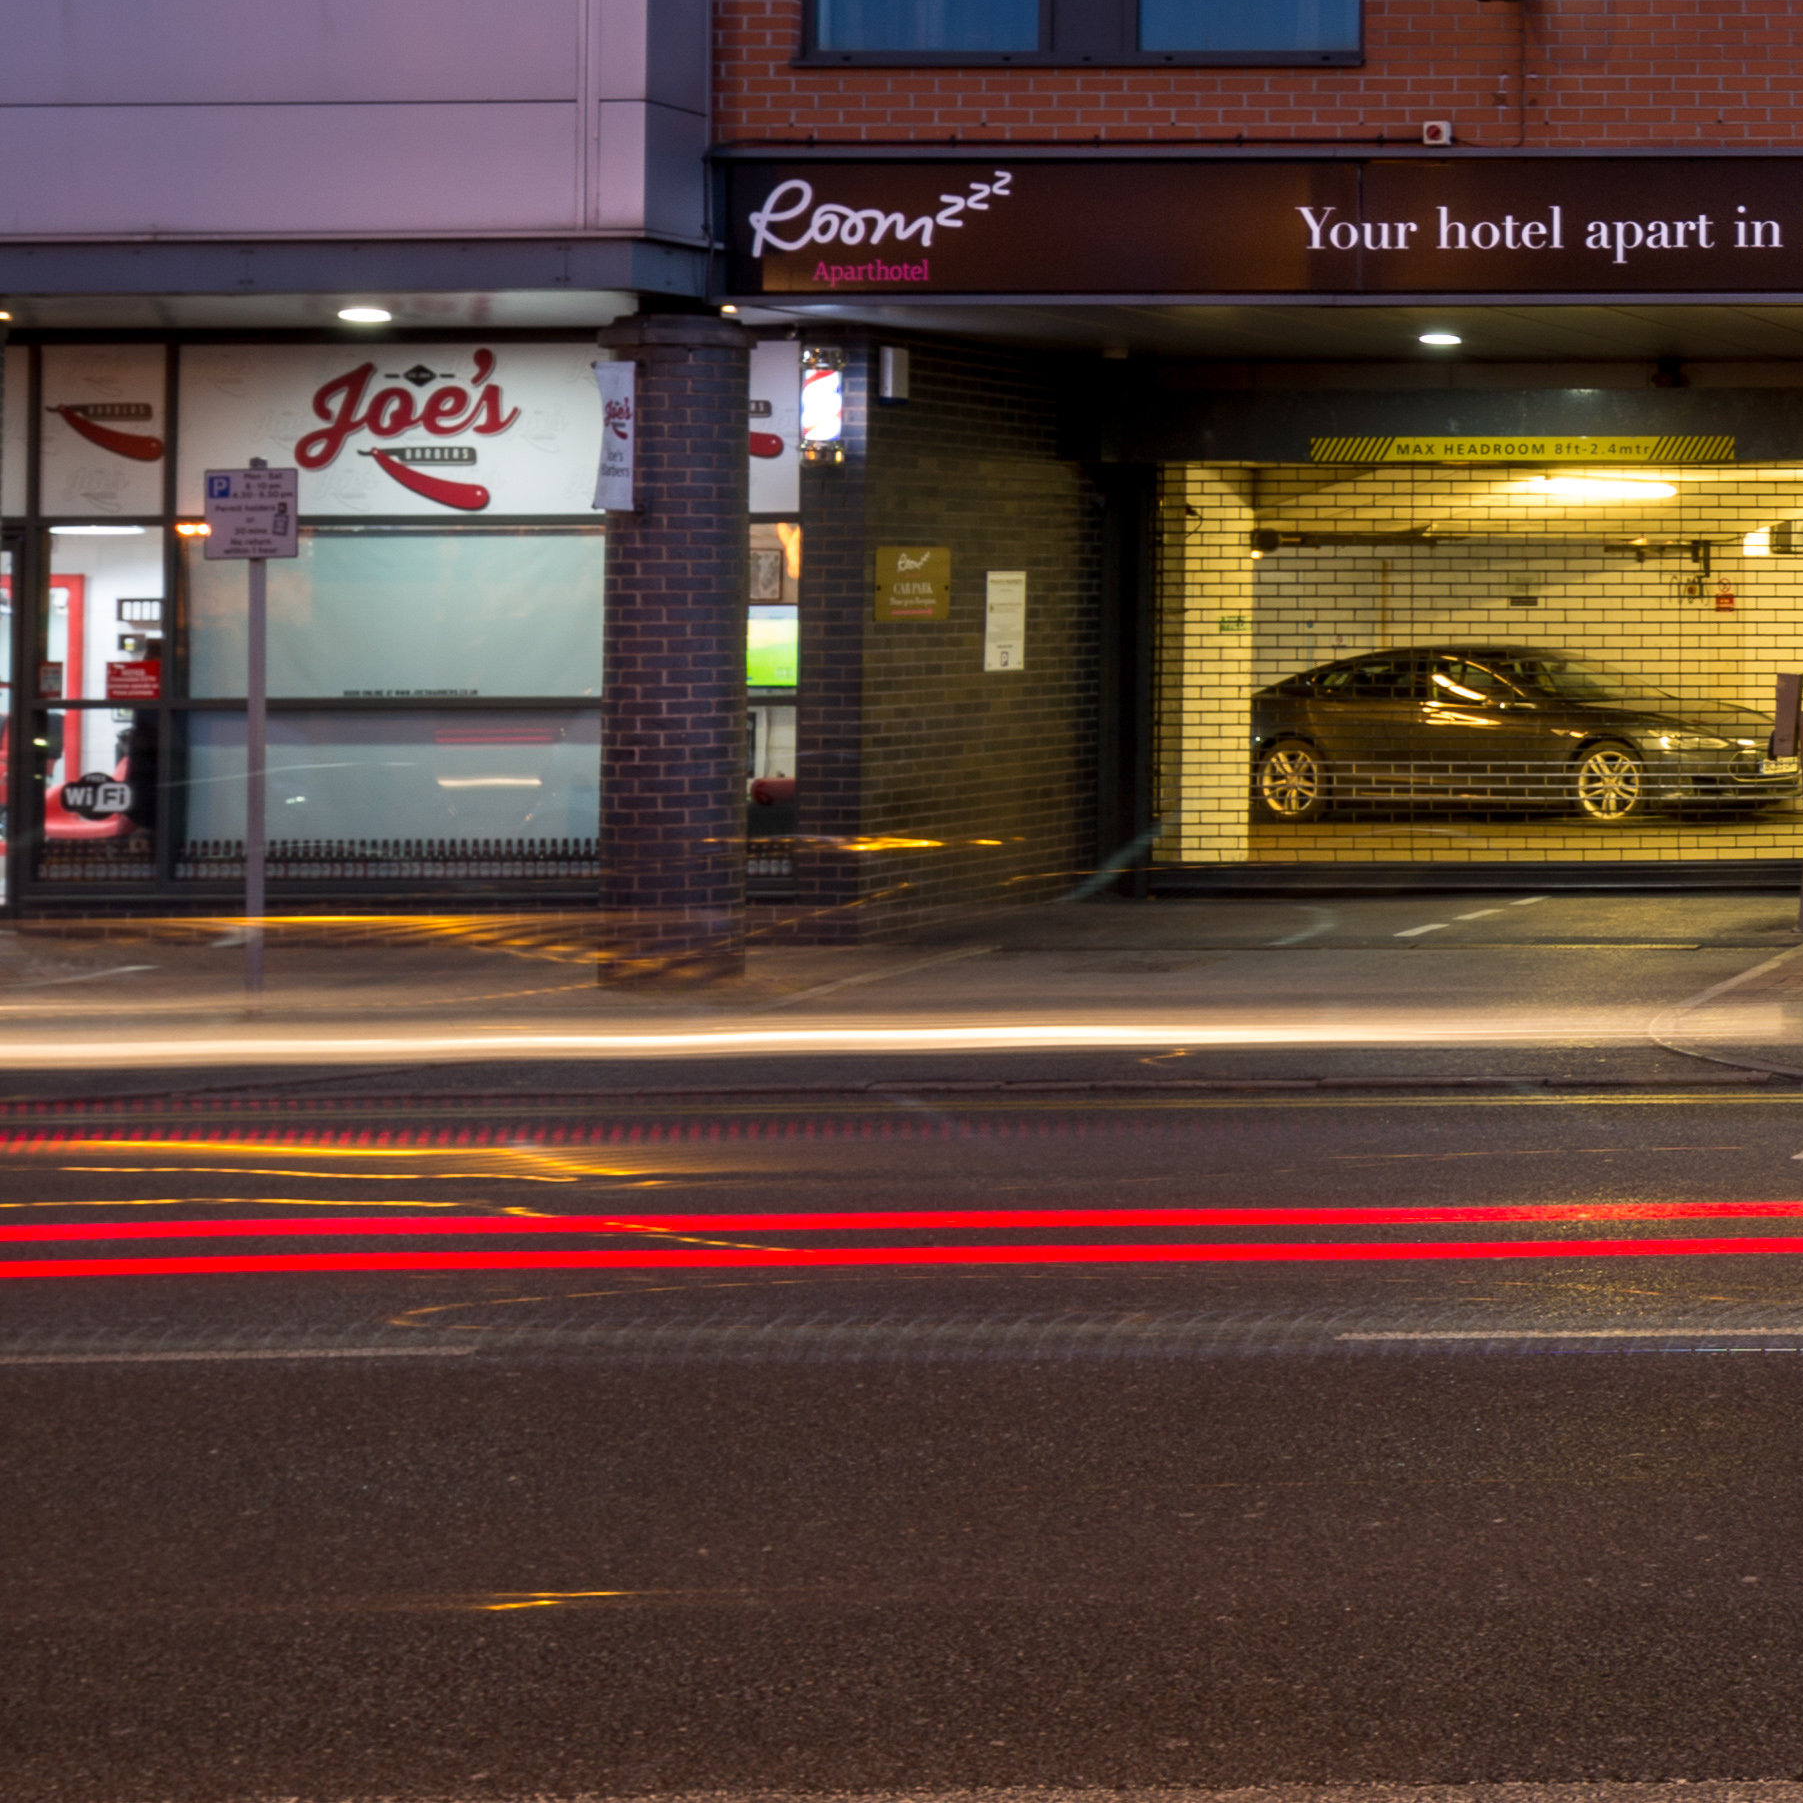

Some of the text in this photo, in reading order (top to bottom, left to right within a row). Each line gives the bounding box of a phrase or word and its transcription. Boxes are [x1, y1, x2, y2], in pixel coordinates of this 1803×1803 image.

[1294, 205, 1418, 250] Your
[1436, 205, 1564, 249] hotel
[1585, 212, 1715, 264] apart
[1733, 205, 1784, 248] in
[813, 259, 930, 288] Aparthotel
[294, 347, 521, 472] Joe's
[404, 448, 470, 460] BARBERS
[1396, 443, 1650, 455] MAX HEADROOM 8ft-2.4mtr
